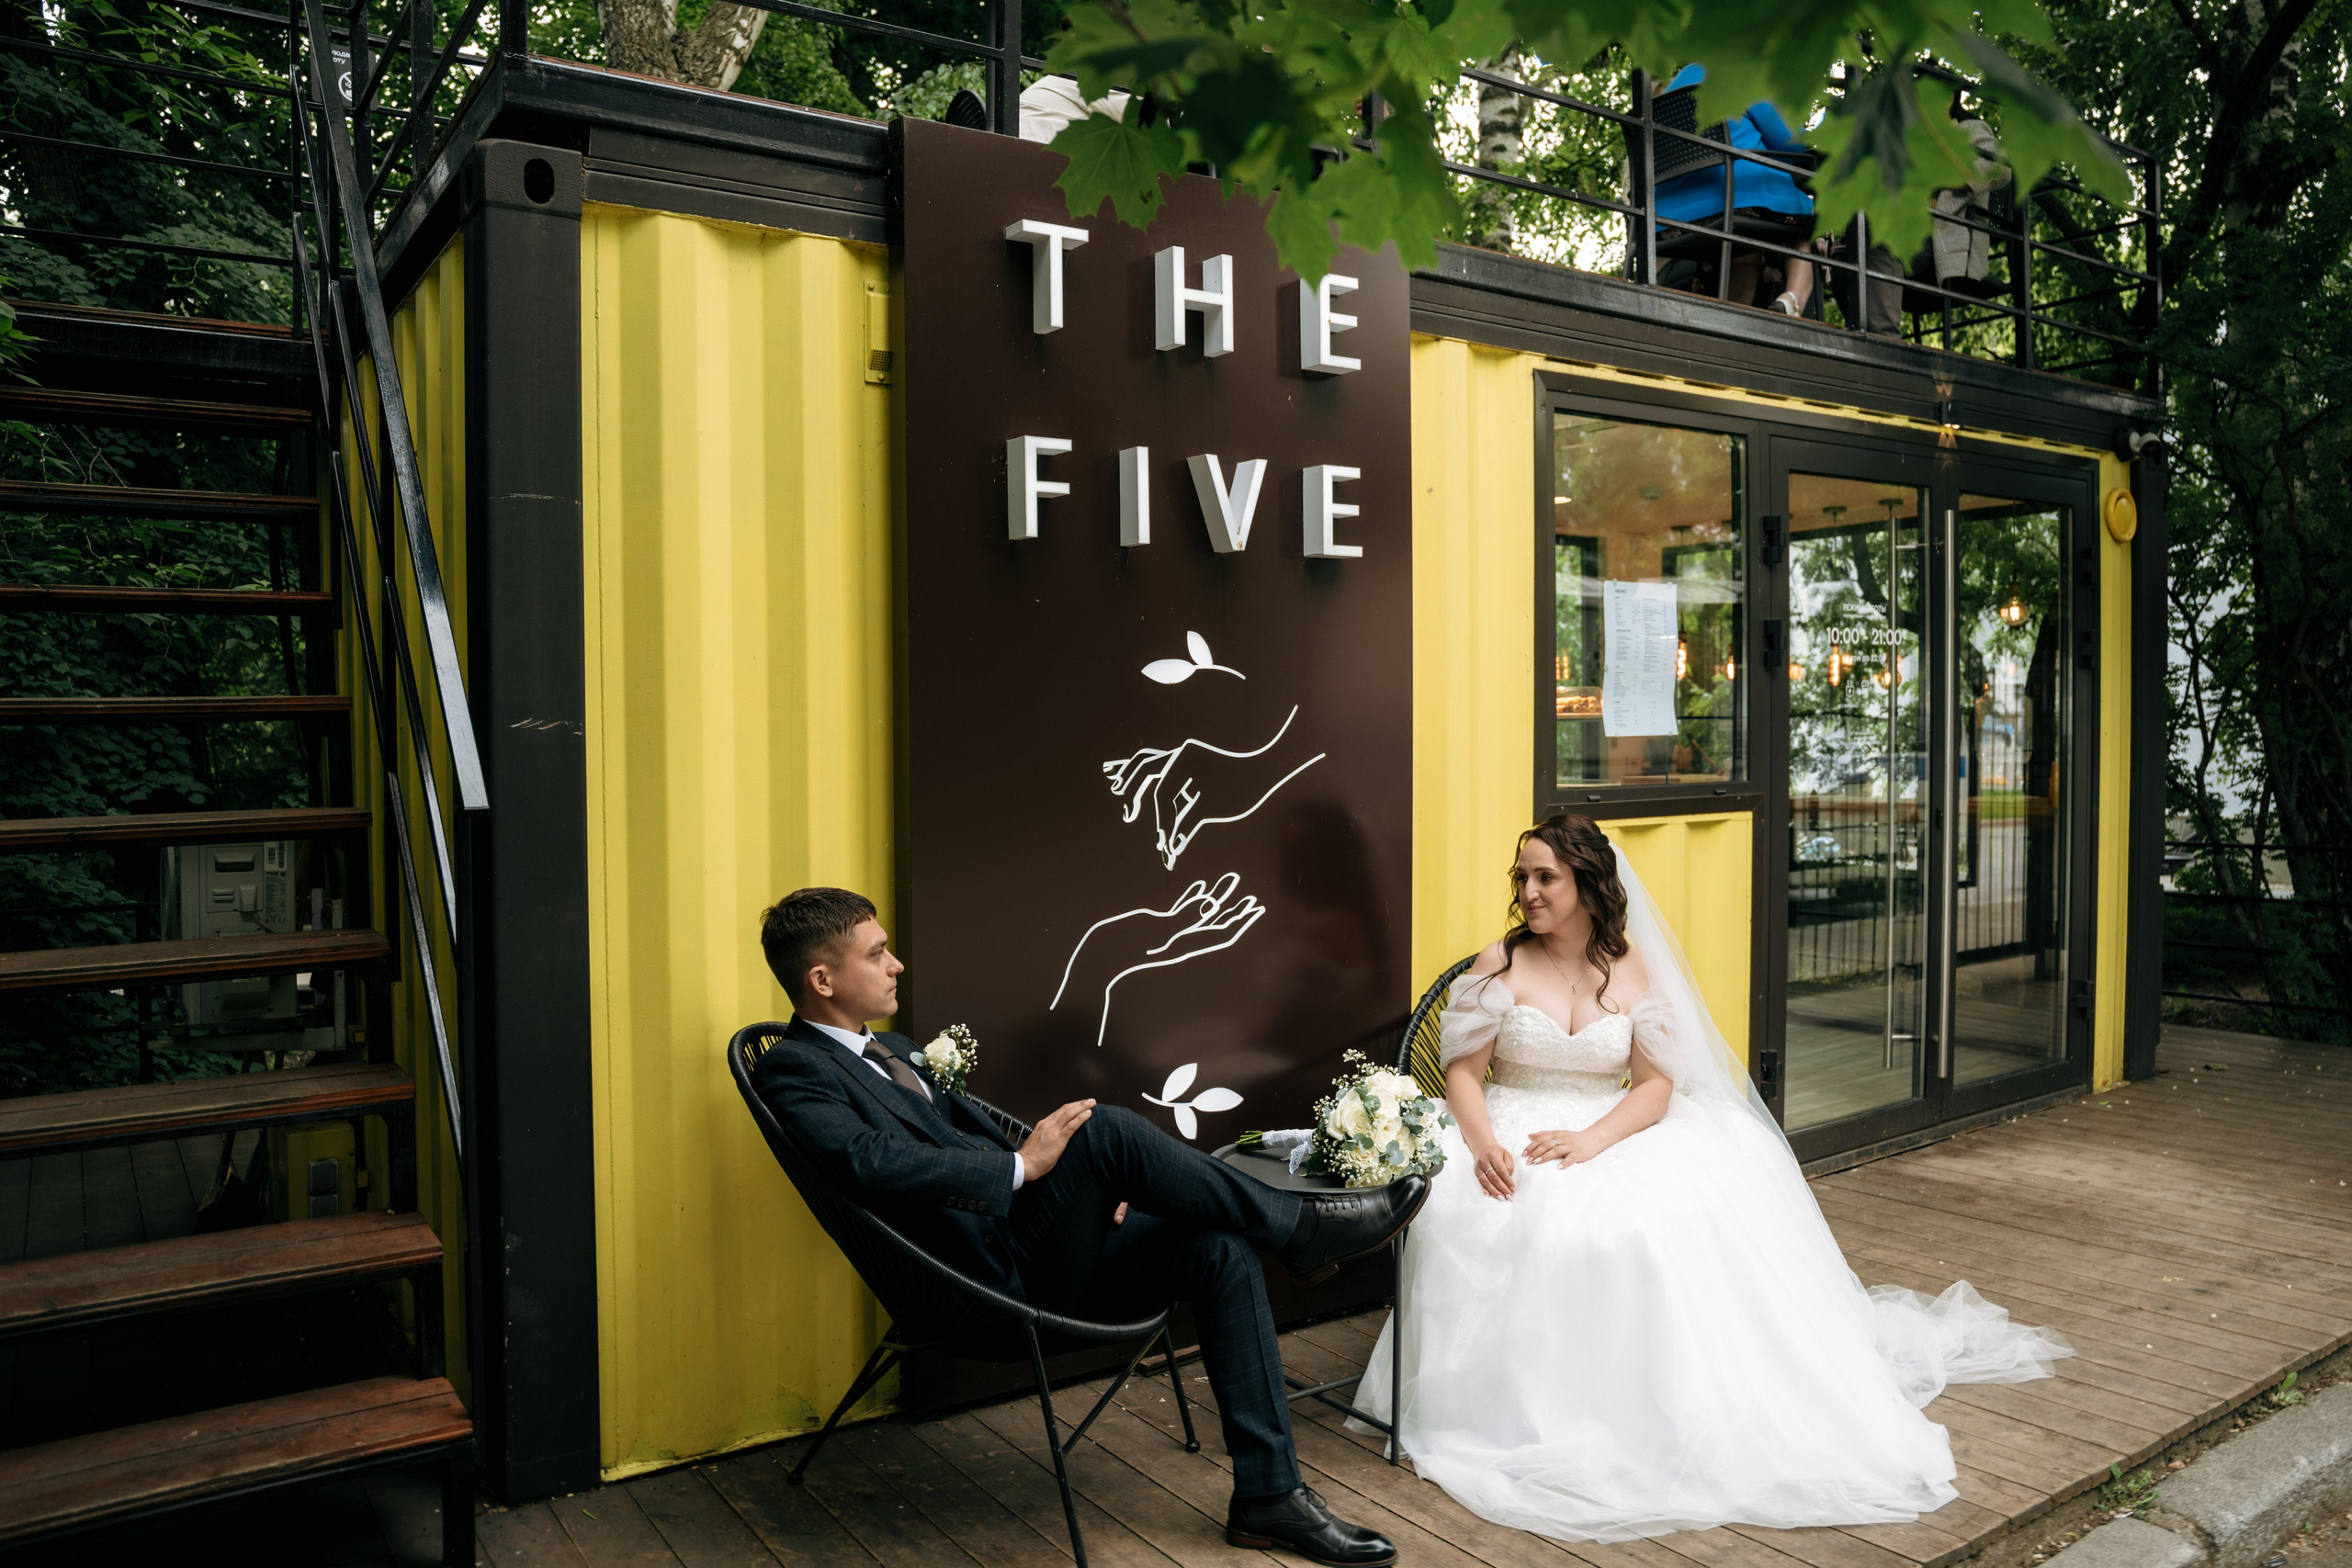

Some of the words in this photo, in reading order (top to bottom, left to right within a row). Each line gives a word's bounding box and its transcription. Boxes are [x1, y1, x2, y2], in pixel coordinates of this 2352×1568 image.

[1005, 219, 1362, 375] THE
[1006, 435, 1363, 558] FIVE
[1826, 627, 1860, 644] 10:00
[1871, 628, 1902, 646] 21:00
